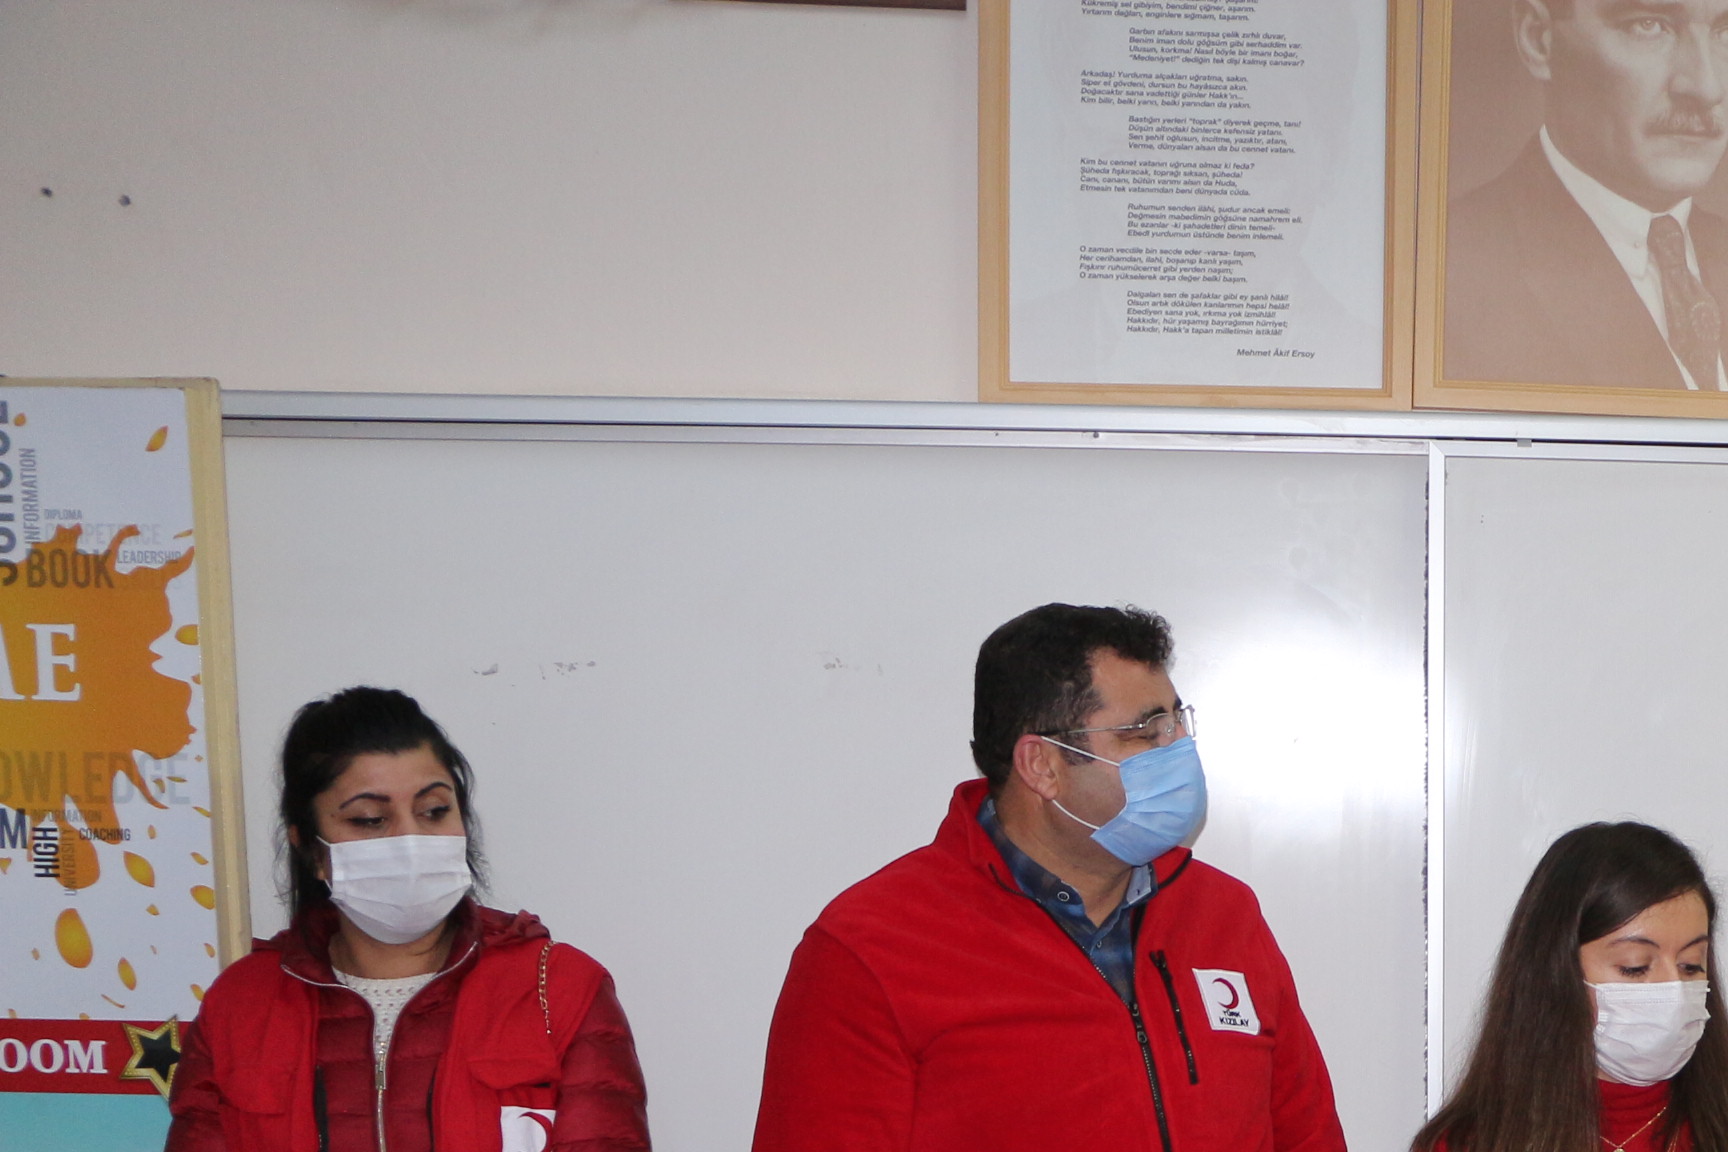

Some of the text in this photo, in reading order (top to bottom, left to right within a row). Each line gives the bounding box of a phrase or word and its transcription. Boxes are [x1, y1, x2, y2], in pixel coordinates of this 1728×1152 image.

[1291, 350, 1315, 359] Ersoy
[19, 448, 40, 544] INFORMATION
[45, 509, 82, 520] DIPLOMA
[26, 548, 114, 589] BOOK
[117, 551, 182, 564] LEADERSHIP
[79, 828, 131, 841] COACHING
[32, 827, 60, 877] HIGH
[60, 829, 77, 896] UNIVERSITY
